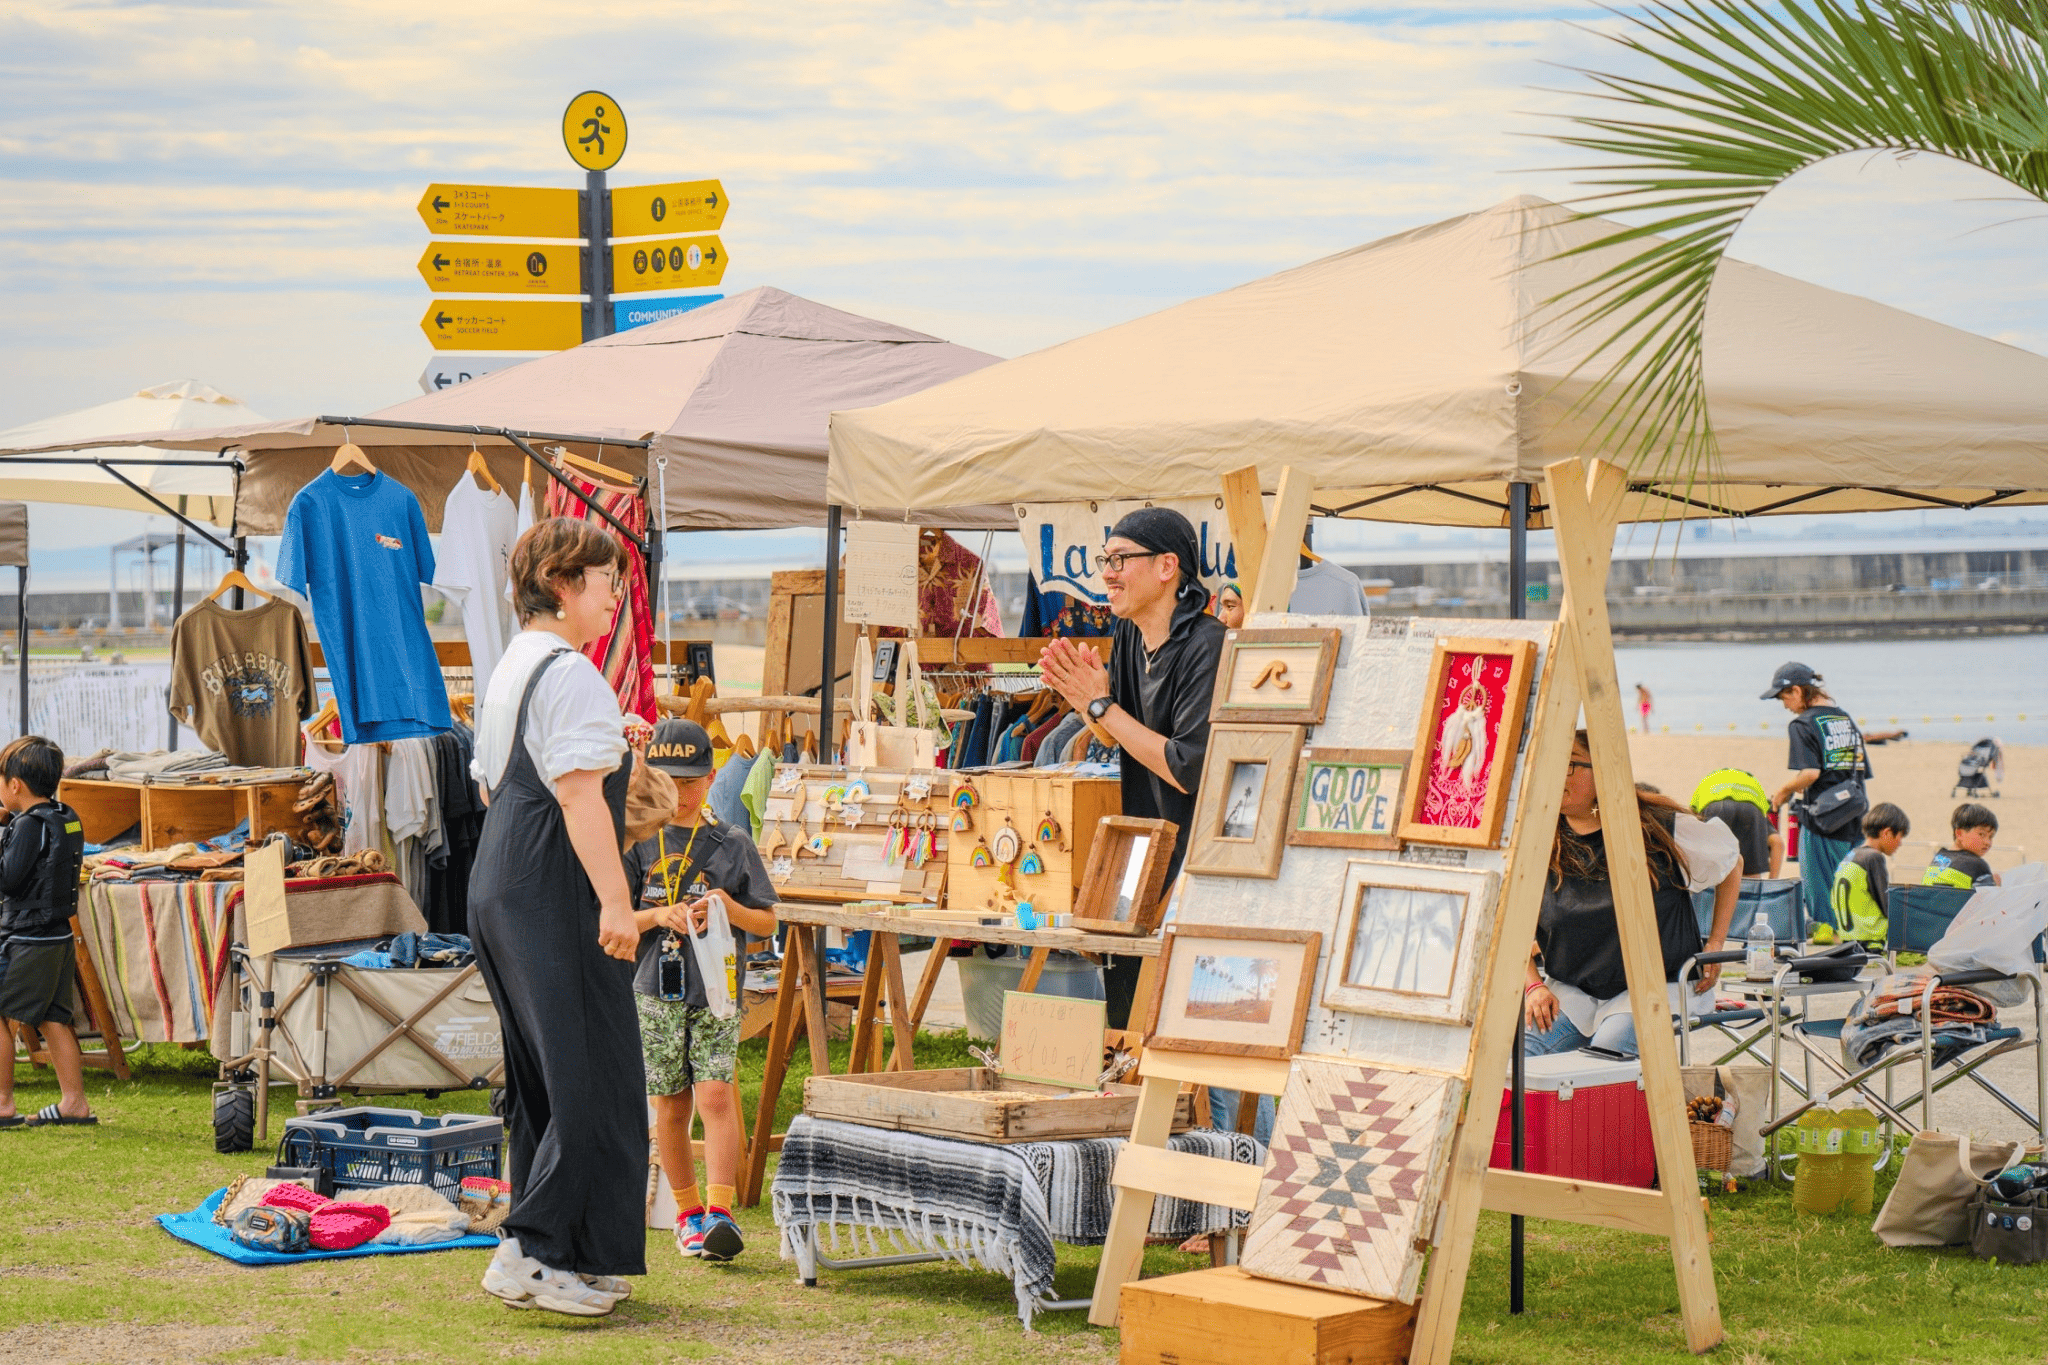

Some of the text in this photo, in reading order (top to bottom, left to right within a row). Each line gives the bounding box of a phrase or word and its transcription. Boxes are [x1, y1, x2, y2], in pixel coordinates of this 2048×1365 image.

[456, 316, 506, 325] サッカーコート
[647, 743, 697, 759] ANAP
[1311, 767, 1381, 806] GOOD
[1316, 795, 1388, 831] WAVE
